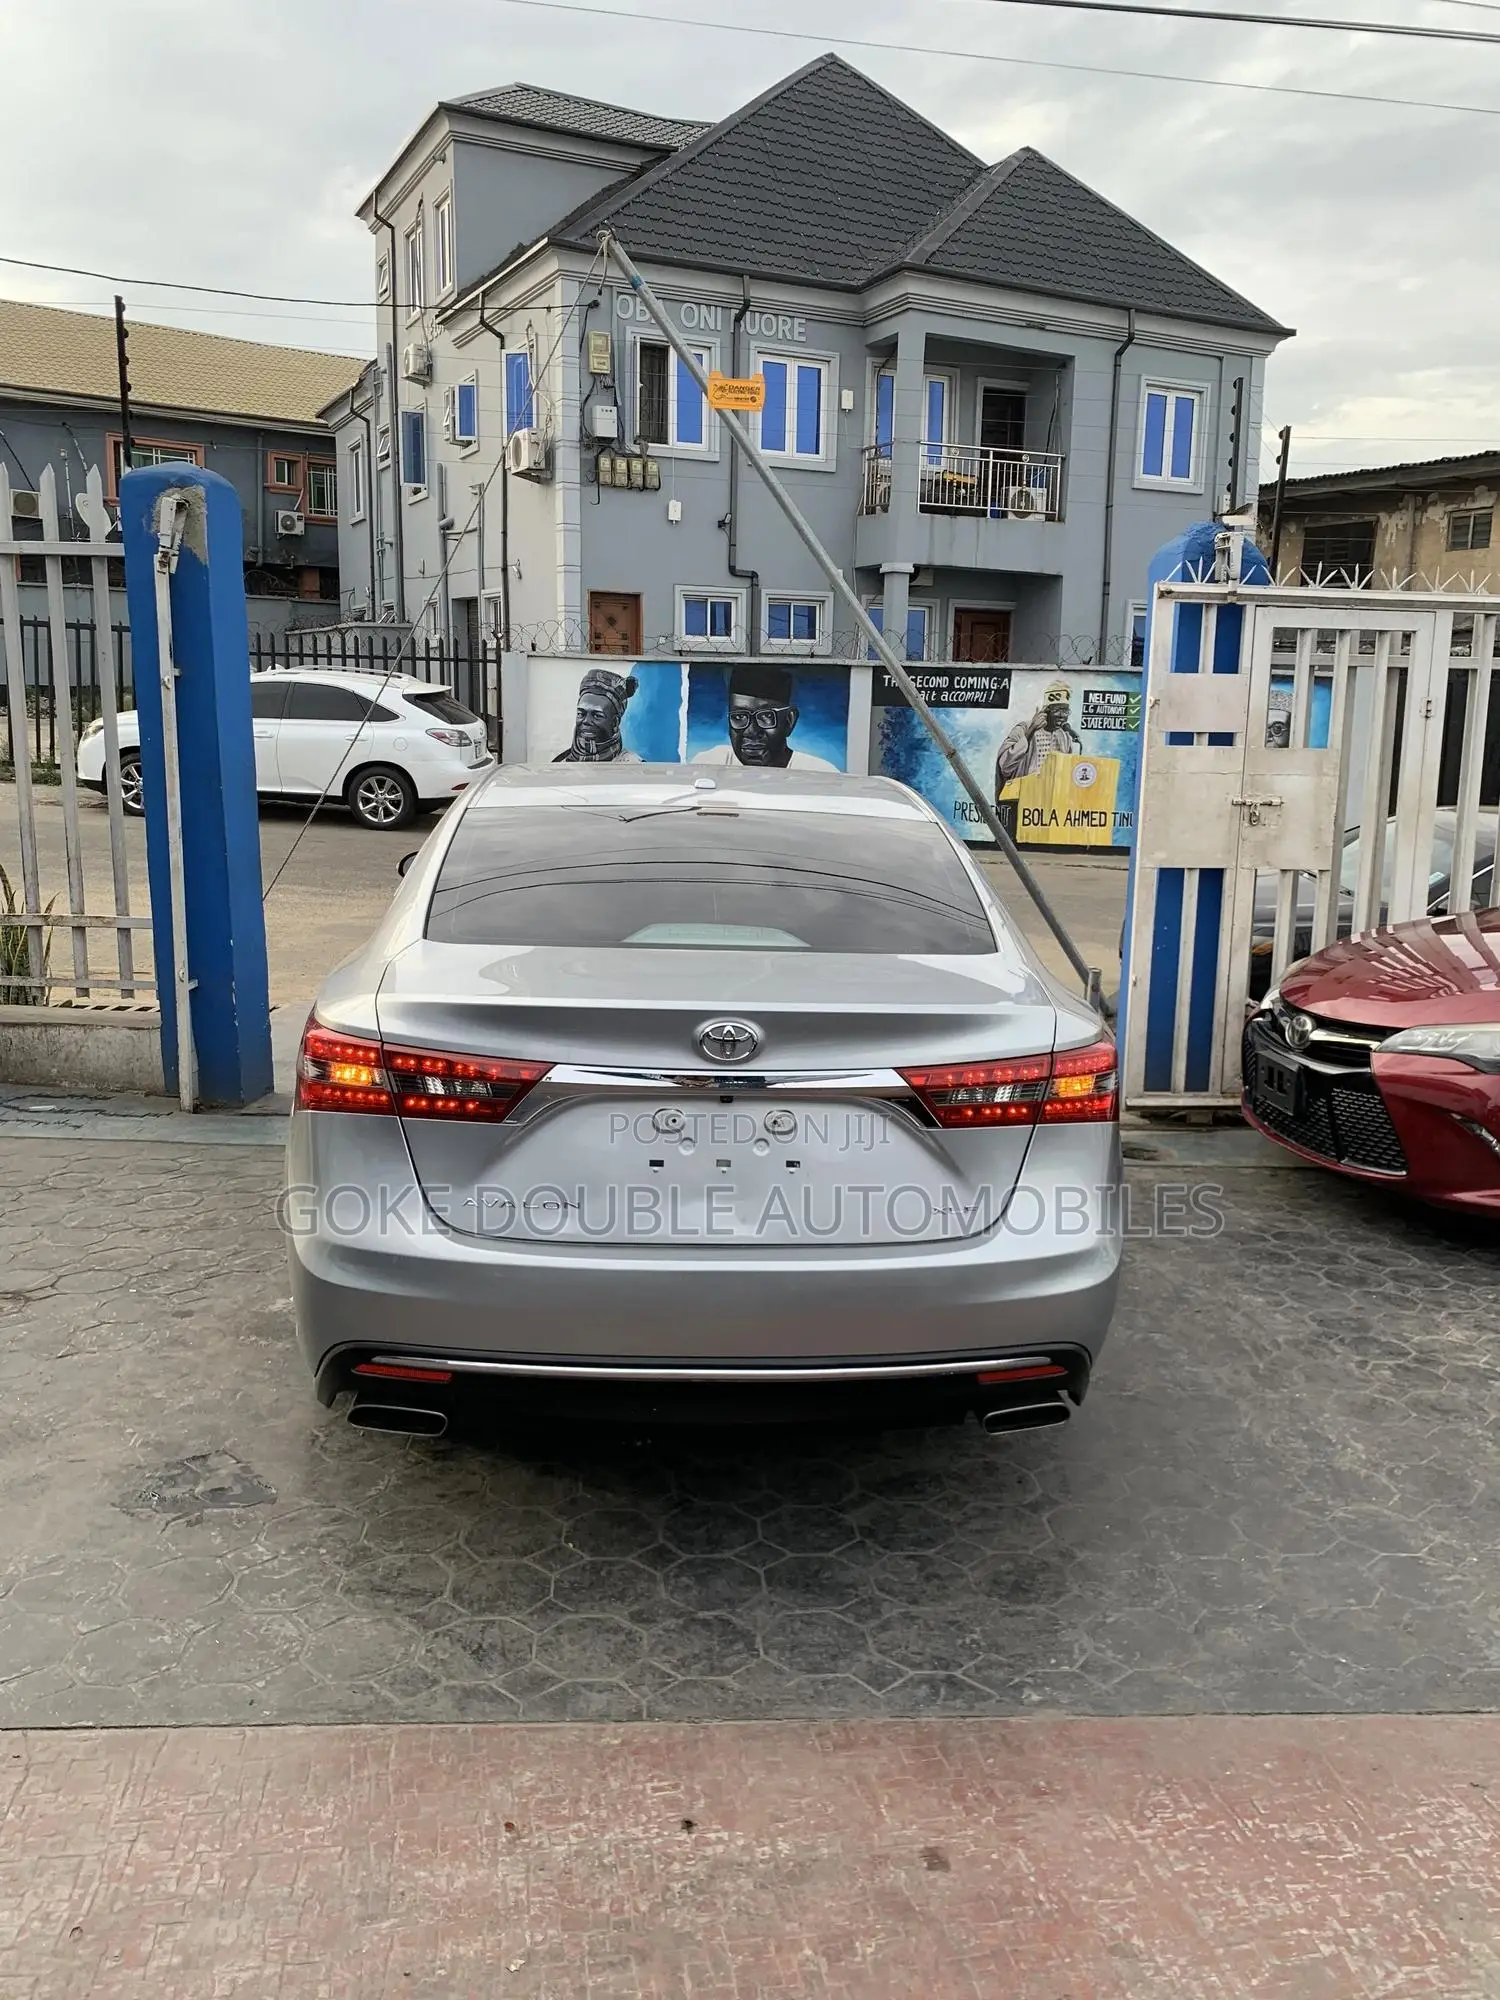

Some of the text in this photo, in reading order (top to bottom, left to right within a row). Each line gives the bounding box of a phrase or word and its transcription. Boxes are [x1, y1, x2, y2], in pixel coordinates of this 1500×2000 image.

[616, 294, 660, 324] OB
[680, 302, 722, 331] ONI
[883, 675, 900, 688] TH
[908, 675, 949, 689] SECOND
[1022, 808, 1060, 827] BOLA
[1063, 809, 1107, 828] AHMED
[462, 1197, 580, 1210] AVALON
